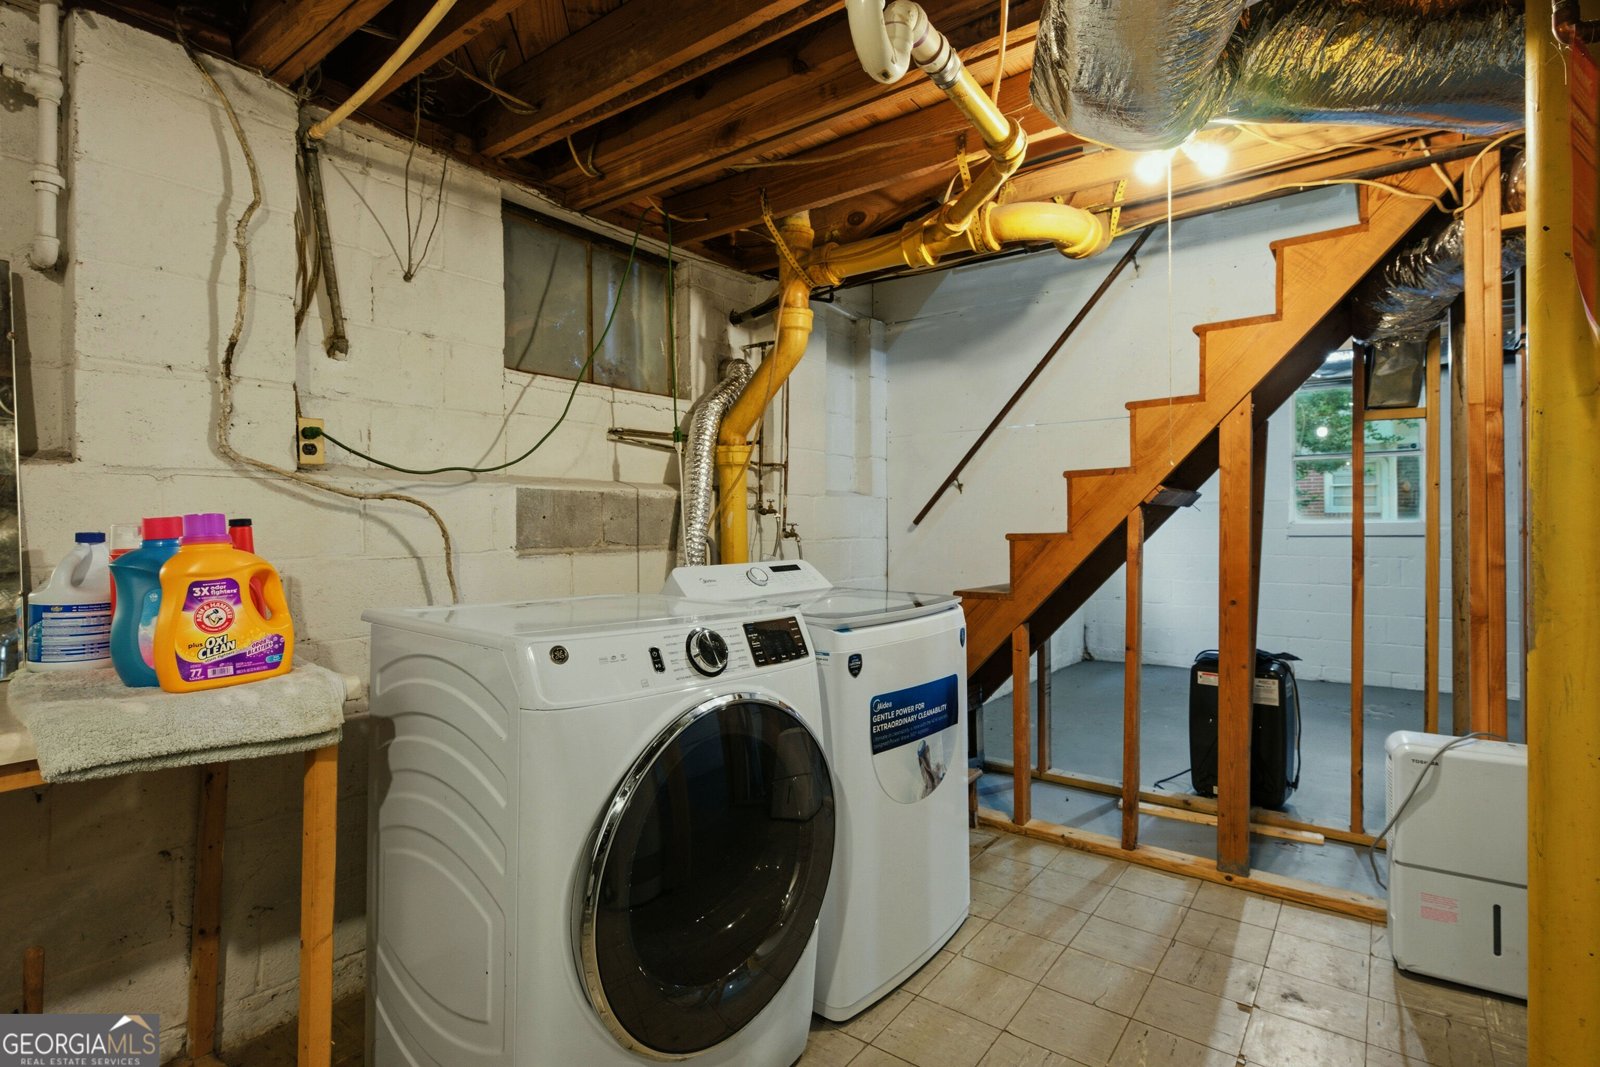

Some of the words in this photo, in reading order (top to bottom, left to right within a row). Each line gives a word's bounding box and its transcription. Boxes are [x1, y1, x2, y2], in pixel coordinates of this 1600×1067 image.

[193, 587, 210, 596] 3X
[210, 588, 236, 596] fighters
[210, 602, 233, 619] HAMMER
[204, 634, 228, 649] OXI
[198, 640, 236, 660] CLEAN
[189, 669, 202, 677] 77
[873, 711, 895, 723] GENTLE
[895, 706, 915, 717] POWER
[915, 702, 925, 711] FOR
[875, 701, 892, 711] Midea
[873, 715, 917, 733] EXTRAORDINARY
[917, 704, 947, 720] CLEANABILITY
